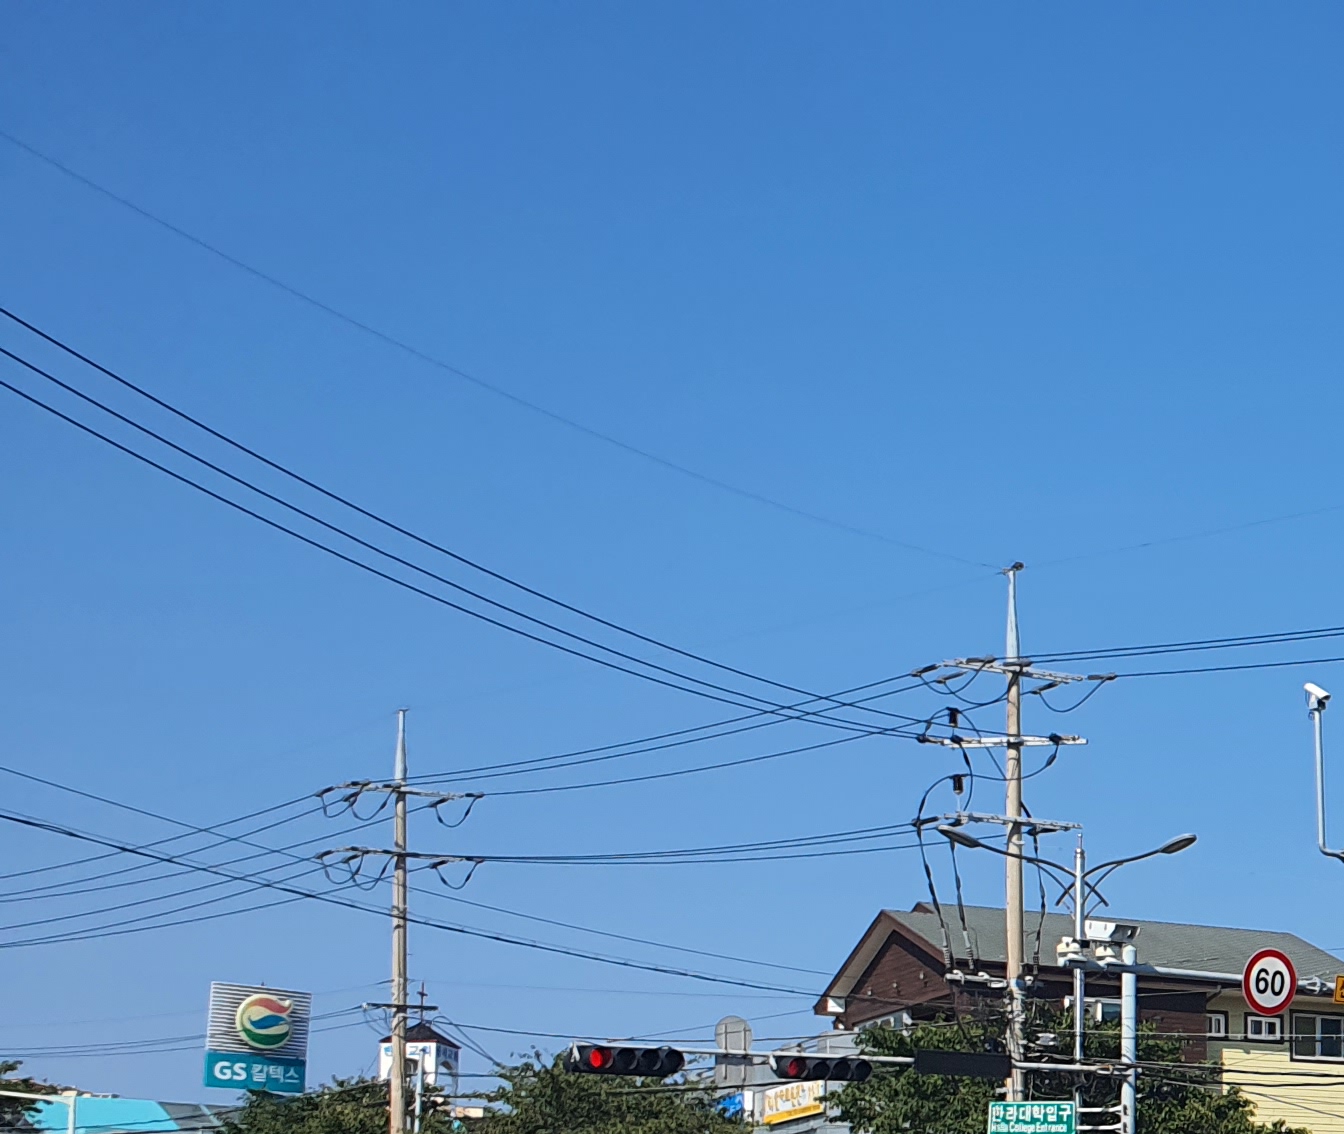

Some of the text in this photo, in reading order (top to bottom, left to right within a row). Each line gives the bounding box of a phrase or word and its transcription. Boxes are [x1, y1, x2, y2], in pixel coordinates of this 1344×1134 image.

[1255, 968, 1285, 996] 60
[214, 1061, 300, 1083] GS 칼텍스
[992, 1105, 1071, 1122] 한라대학입구
